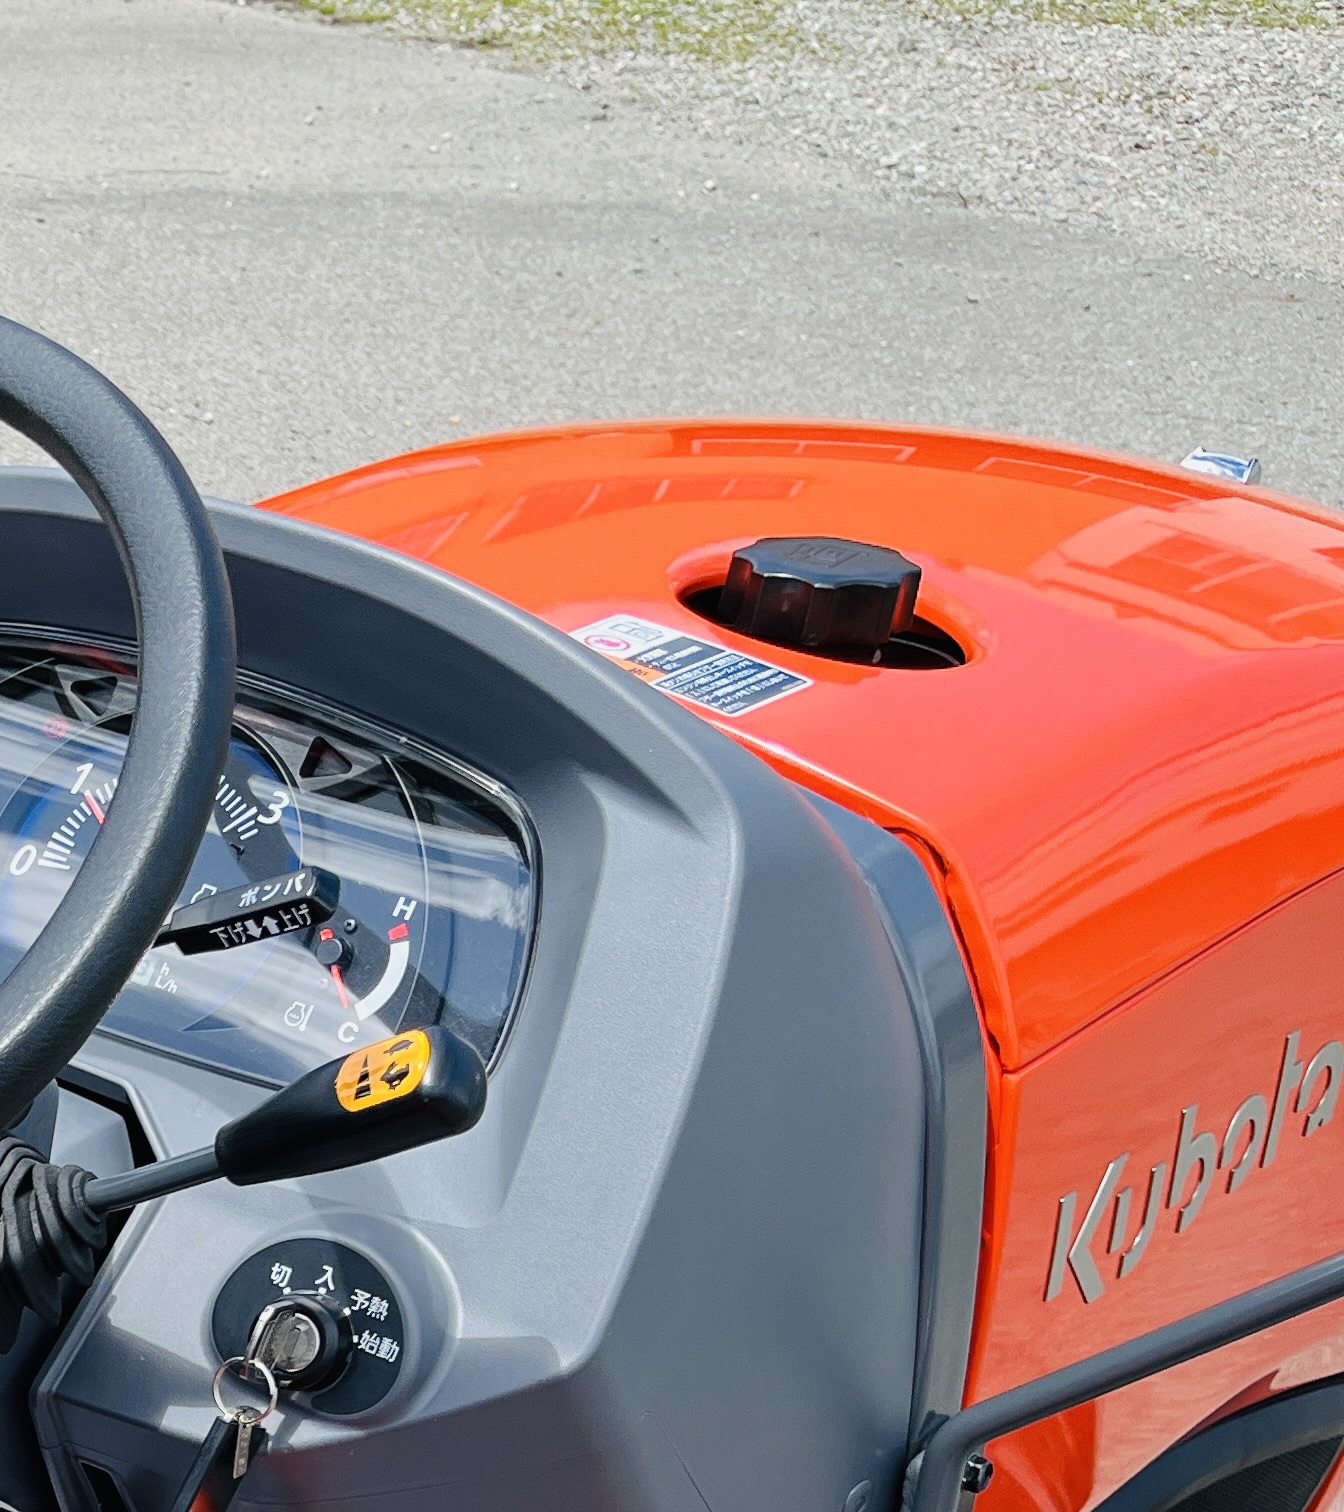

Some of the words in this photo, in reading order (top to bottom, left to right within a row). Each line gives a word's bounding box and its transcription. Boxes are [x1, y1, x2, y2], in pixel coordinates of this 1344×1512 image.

[70, 763, 95, 794] 1
[257, 791, 291, 825] 3
[9, 844, 37, 876] 0
[392, 896, 417, 921] H
[209, 921, 247, 949] 下げ
[279, 903, 312, 932] 上げ
[337, 1021, 359, 1043] C
[1043, 1028, 1344, 1304] Kubota
[270, 1262, 293, 1288] 切
[315, 1265, 336, 1291] 入
[350, 1288, 391, 1321] 予熱
[358, 1330, 400, 1363] 始動
